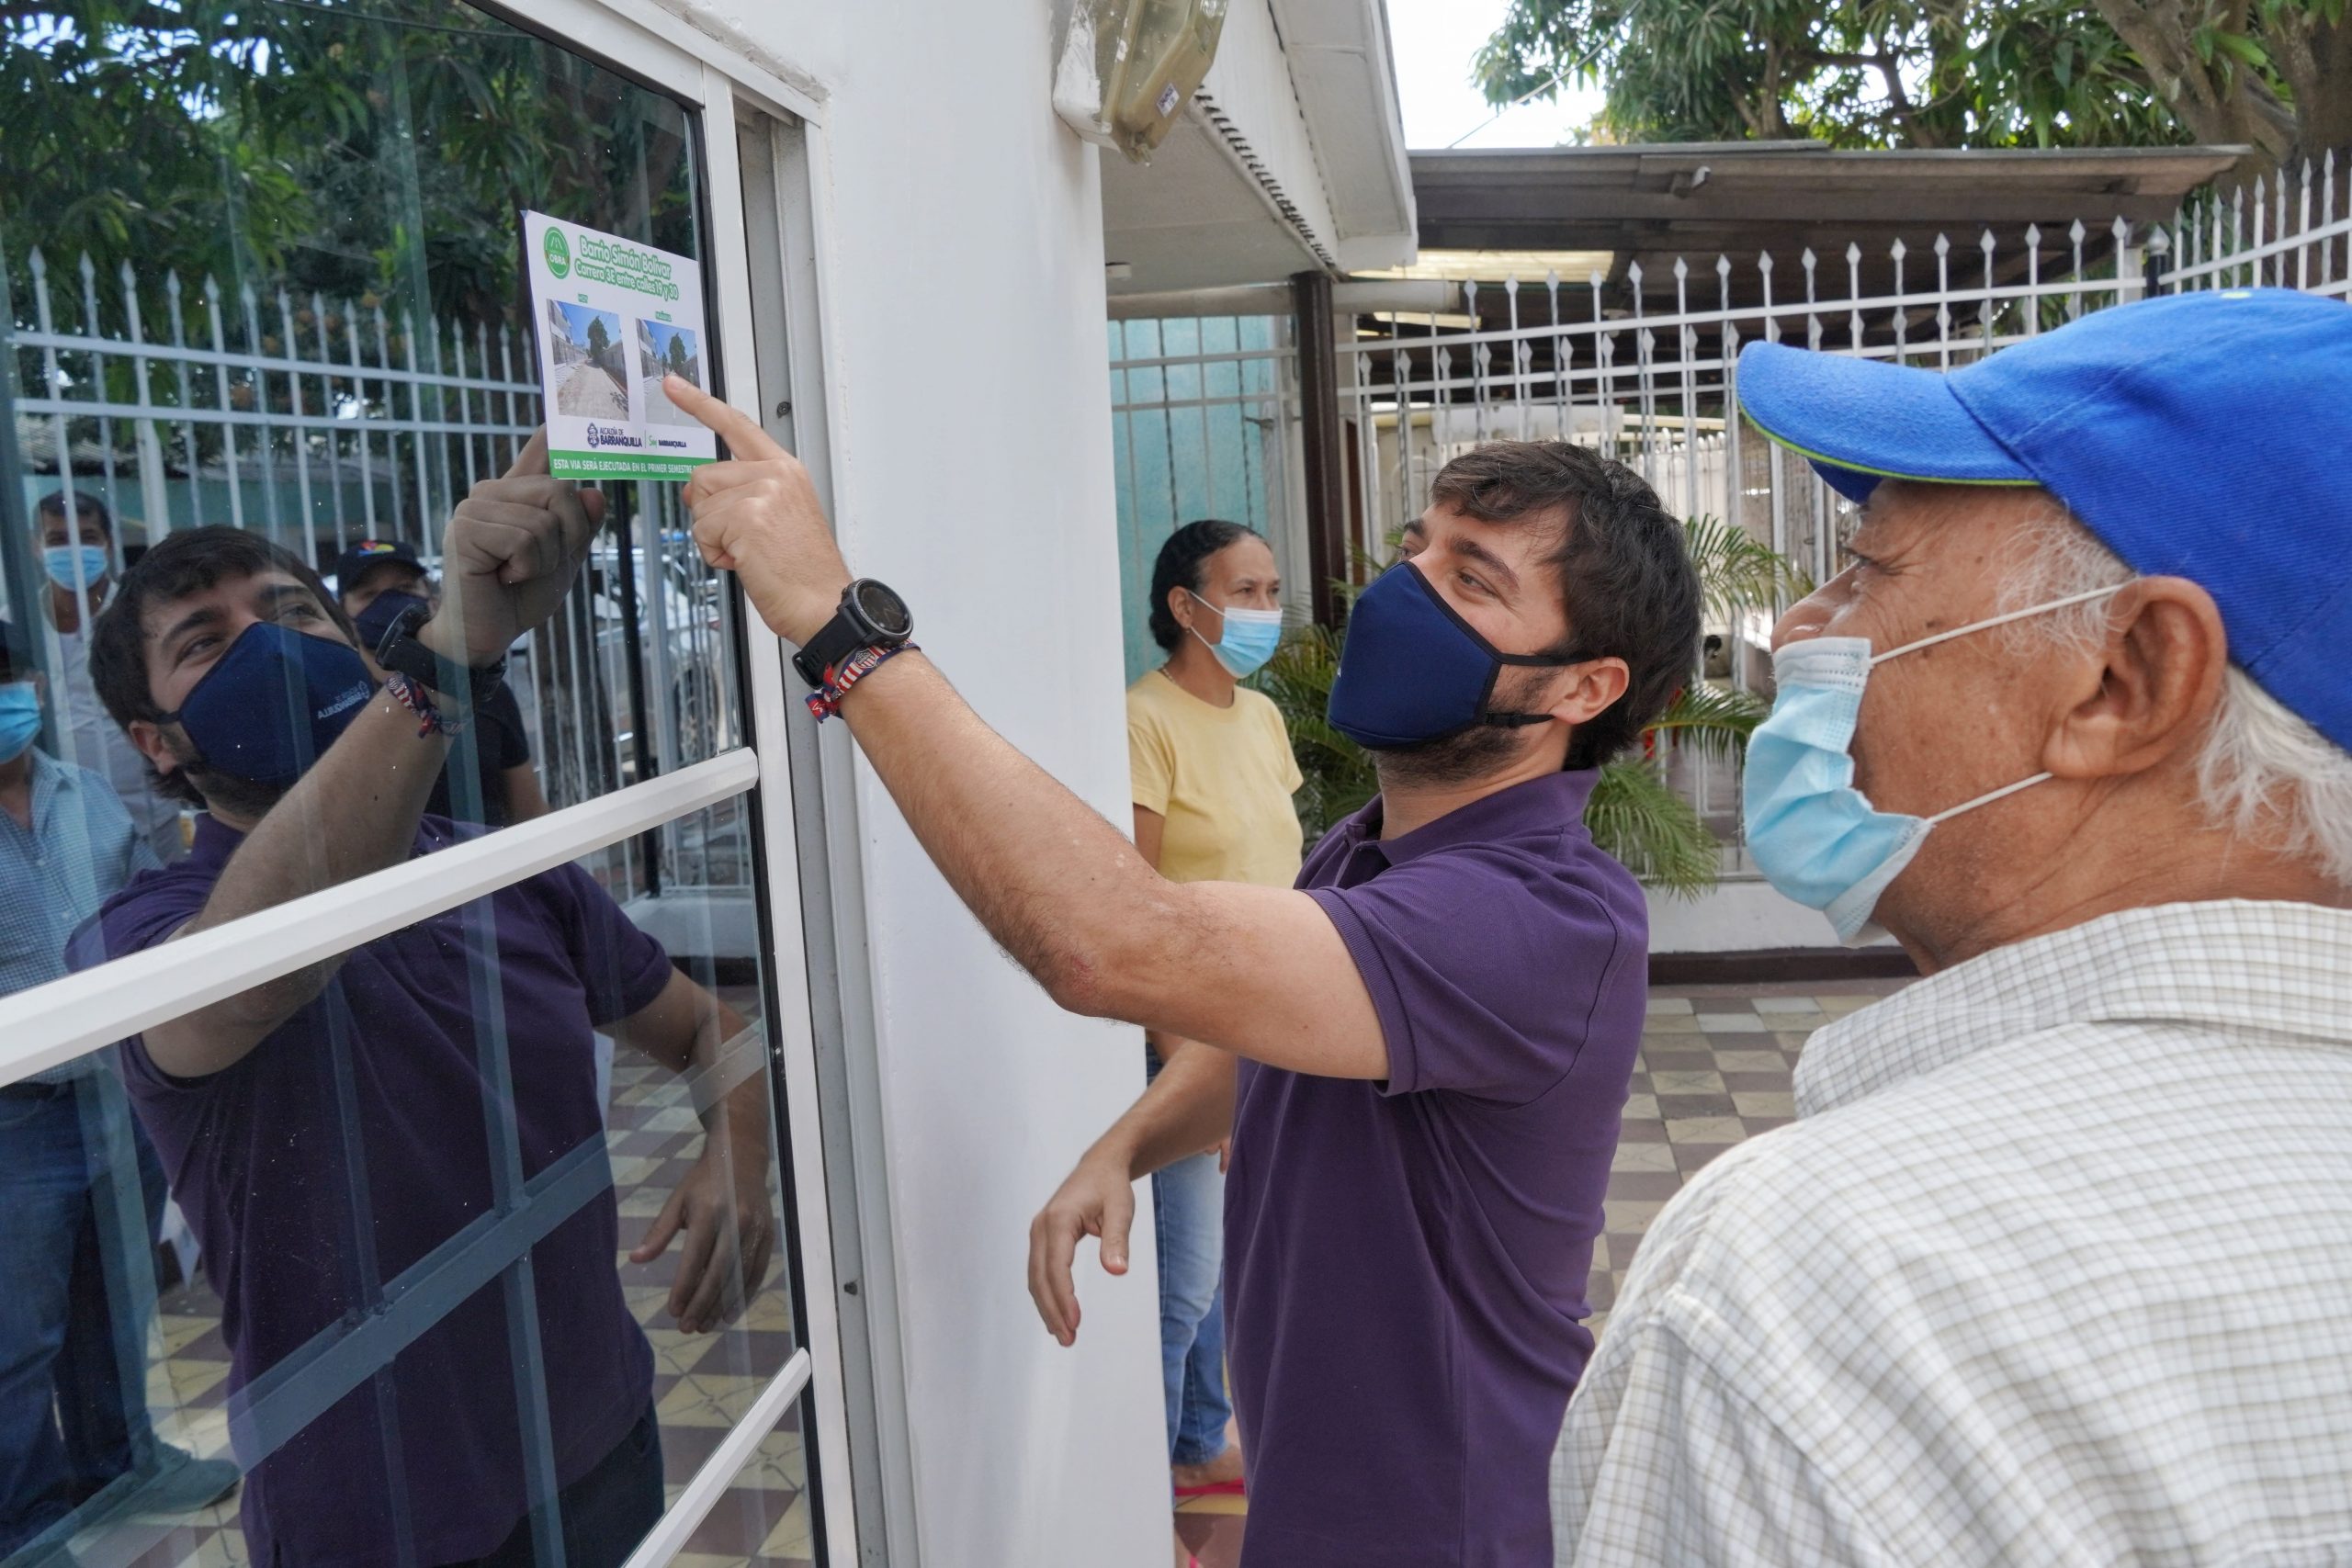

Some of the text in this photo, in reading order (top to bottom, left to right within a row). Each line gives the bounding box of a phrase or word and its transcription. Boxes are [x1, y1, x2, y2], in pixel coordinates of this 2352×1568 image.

[549, 254, 567, 265] OBRA
[580, 235, 611, 263] Barrio
[611, 244, 641, 271] Simón
[575, 258, 605, 281] Carrera
[605, 266, 616, 284] 3E
[616, 272, 636, 288] entre
[662, 284, 670, 301] y
[669, 283, 679, 300] 30
[600, 427, 617, 435] ALCALDÍA
[600, 435, 642, 447] BARRANQUILLA
[553, 458, 569, 469] ESTA
[570, 460, 582, 470] VIA
[582, 457, 597, 471] SERÁ
[599, 461, 630, 472] EJECUTADA
[631, 463, 640, 472] EN
[640, 463, 647, 472] EL
[648, 463, 667, 473] PRIMER
[668, 464, 692, 474] SEMESTRE
